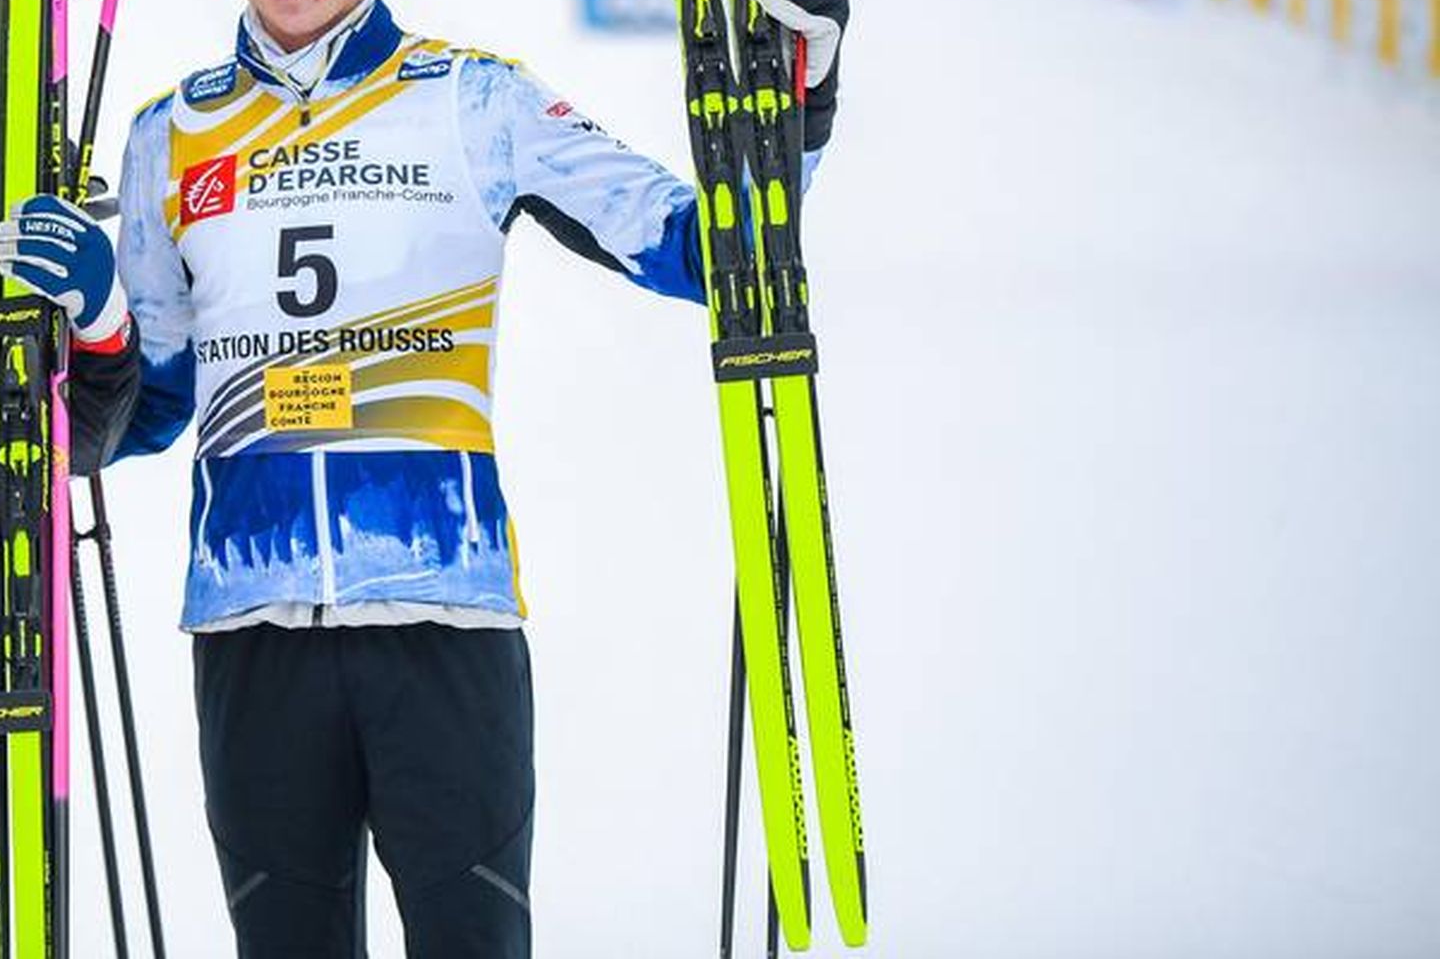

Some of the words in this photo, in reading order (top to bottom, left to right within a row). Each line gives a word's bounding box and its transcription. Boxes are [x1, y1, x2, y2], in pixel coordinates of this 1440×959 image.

[249, 140, 361, 169] CAISSE
[248, 164, 430, 195] D'EPARGNE
[247, 191, 330, 210] Bourgogne
[276, 224, 338, 318] 5
[279, 328, 330, 355] DES
[340, 327, 454, 353] ROUSSES
